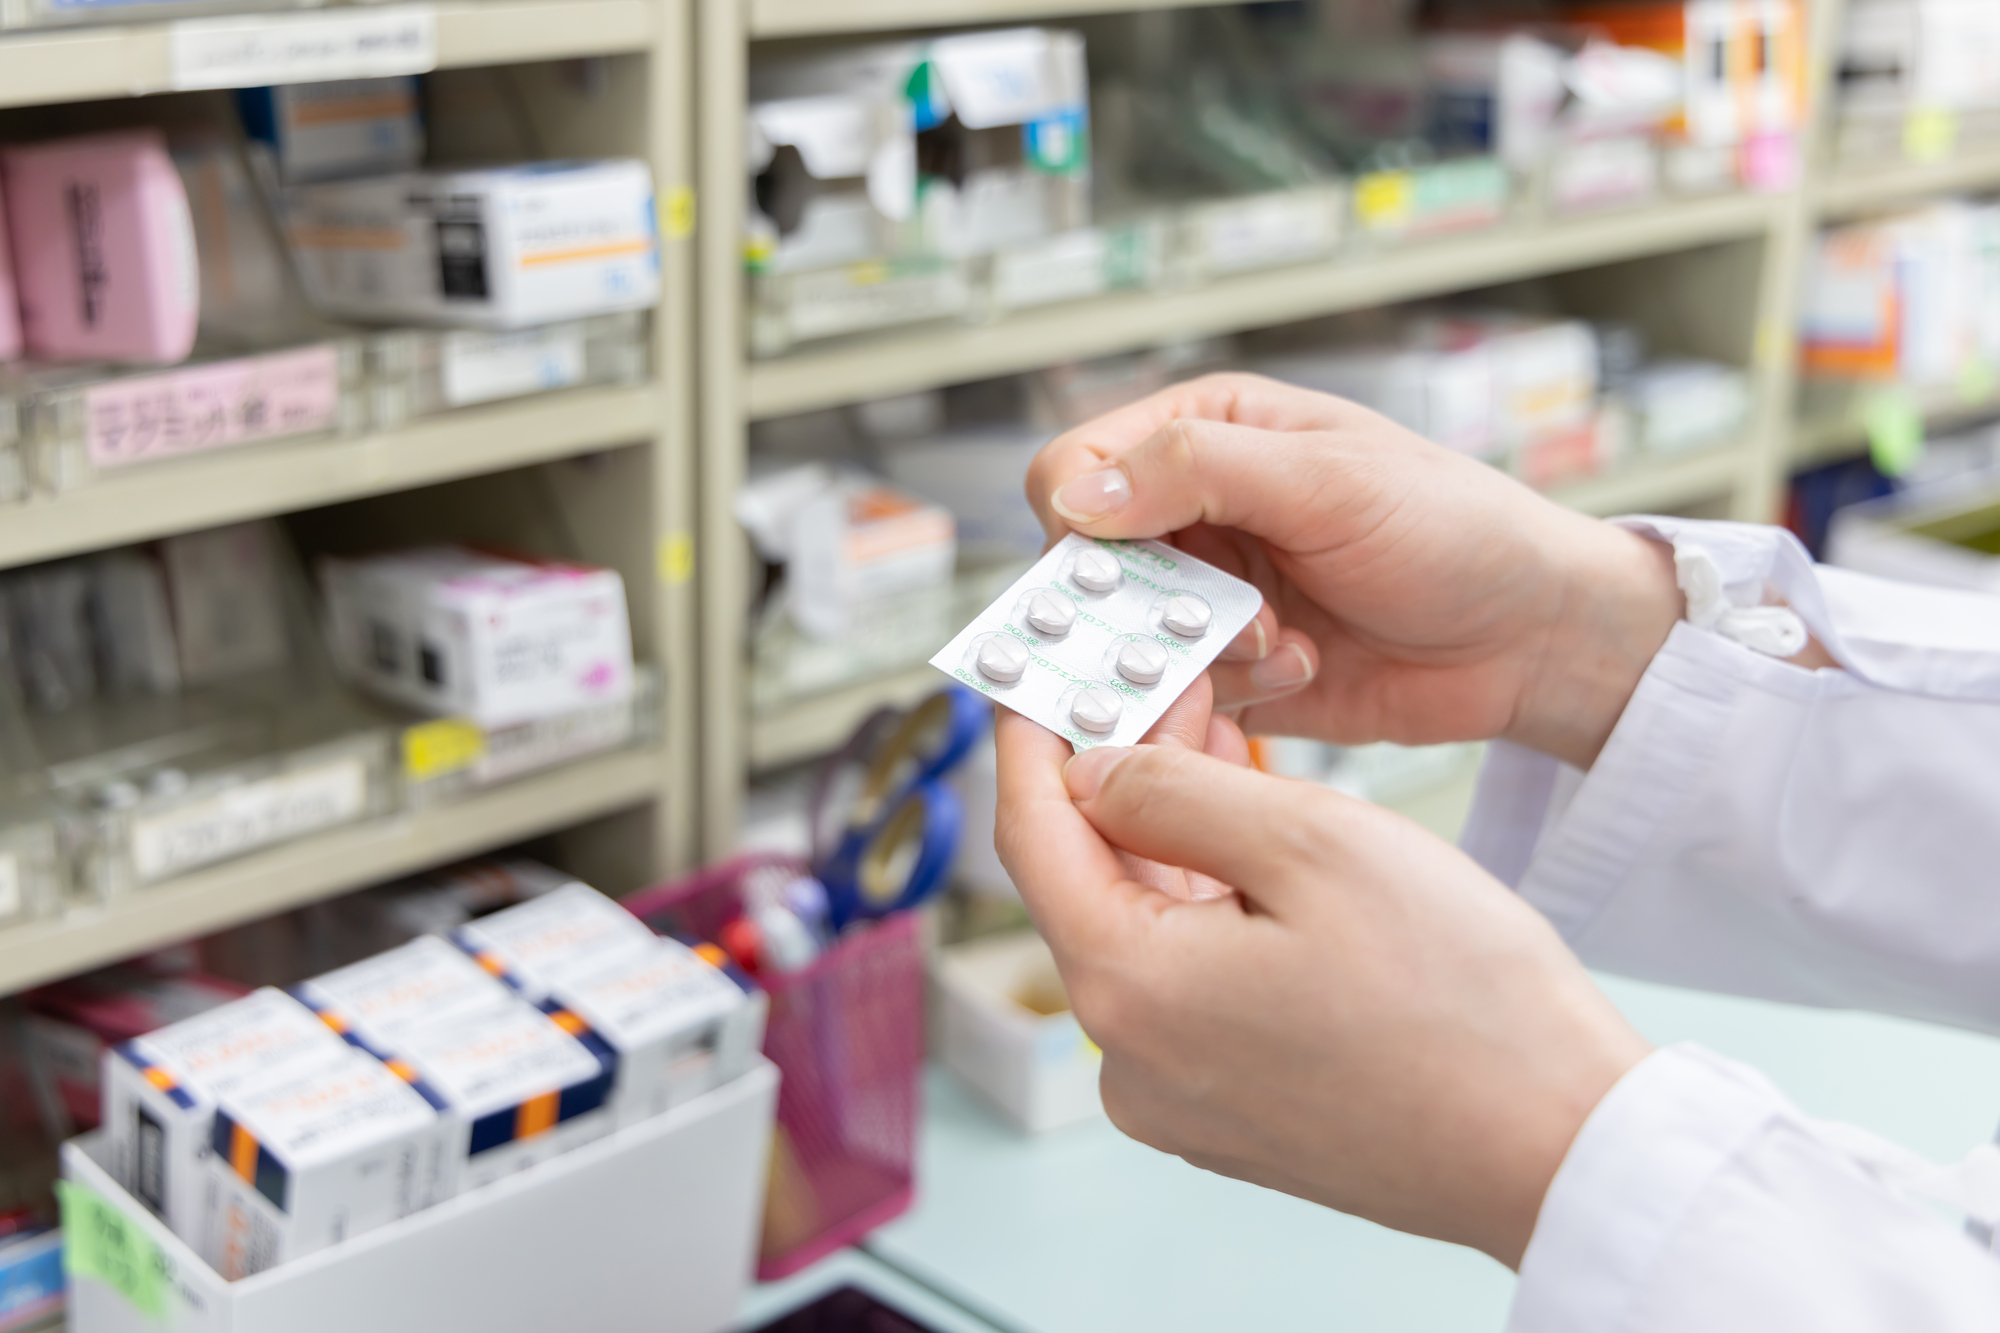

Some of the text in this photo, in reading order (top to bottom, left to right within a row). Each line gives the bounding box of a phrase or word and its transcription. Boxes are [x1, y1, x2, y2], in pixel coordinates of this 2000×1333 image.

[1155, 632, 1192, 656] 60mg
[953, 668, 993, 693] 60mg
[1062, 726, 1101, 750] 60m
